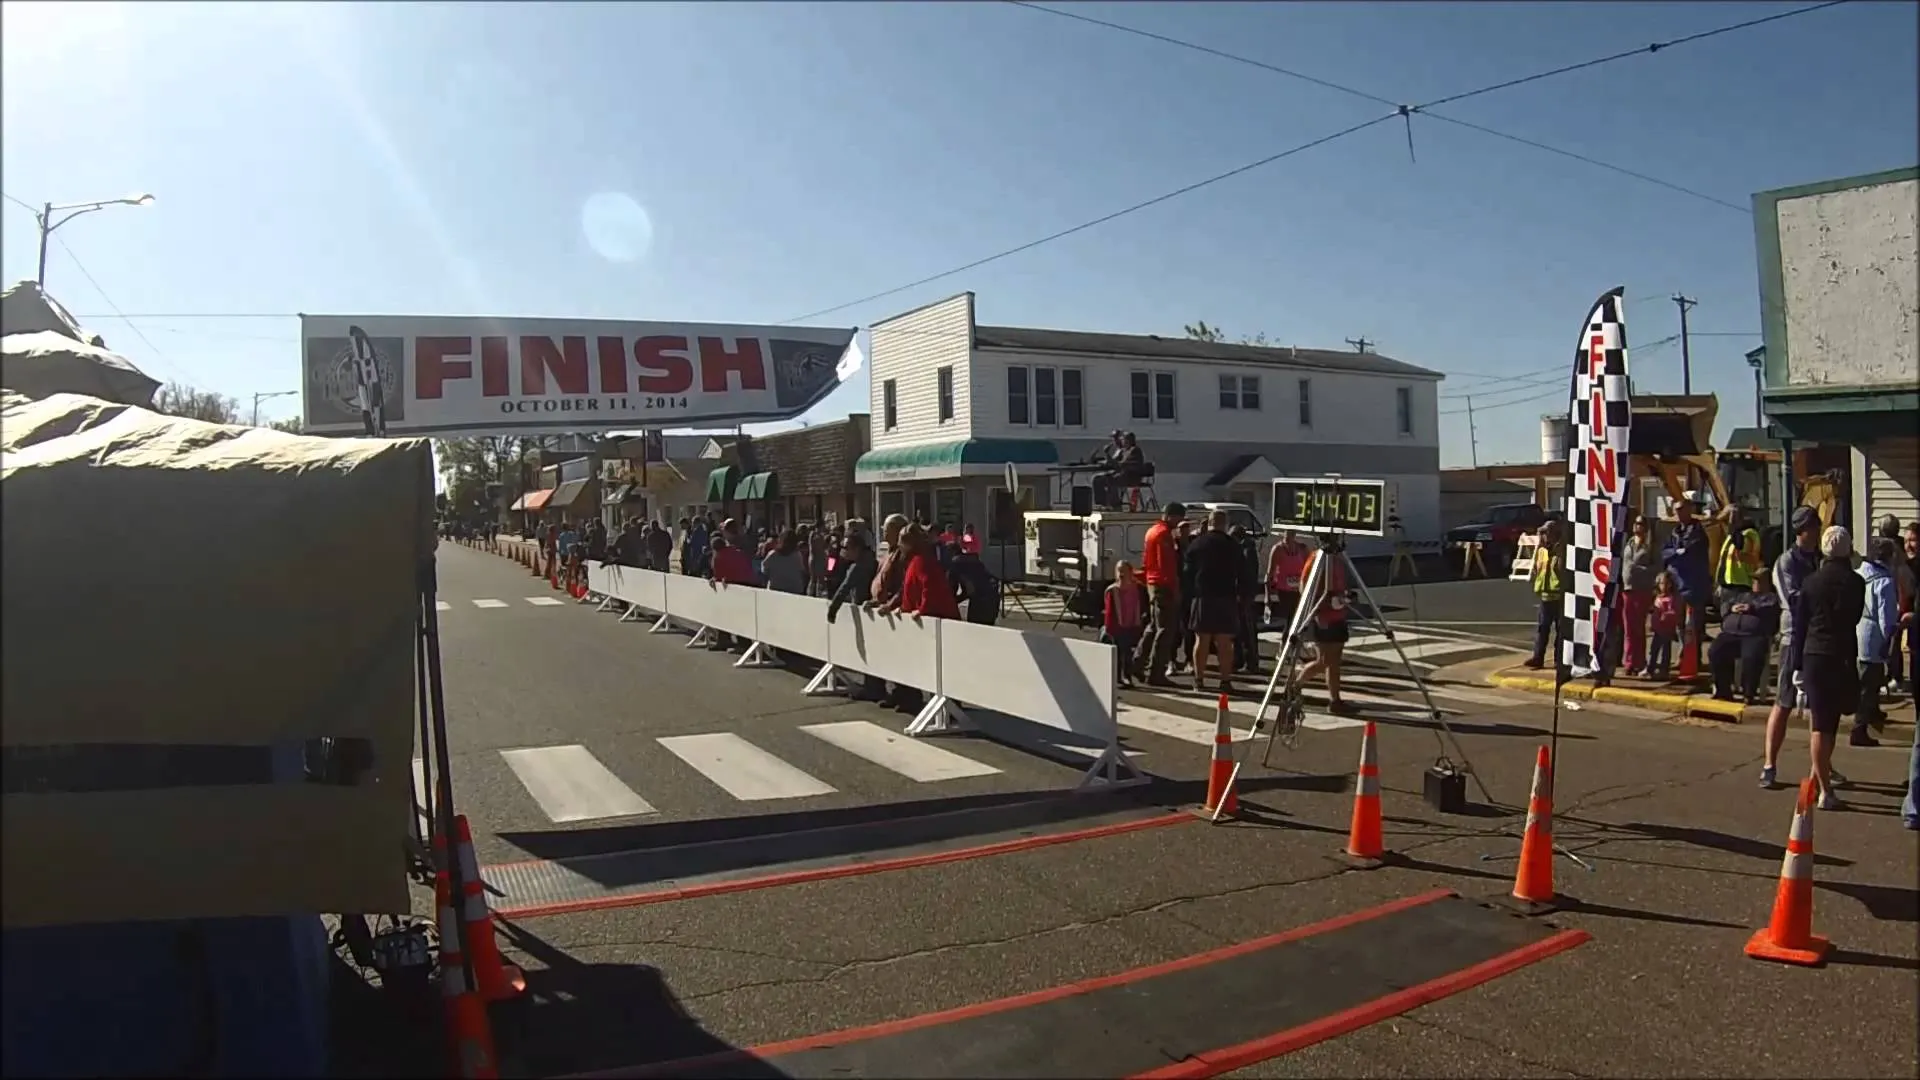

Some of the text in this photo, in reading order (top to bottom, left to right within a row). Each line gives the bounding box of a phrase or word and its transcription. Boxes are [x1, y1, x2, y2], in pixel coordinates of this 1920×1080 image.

[415, 335, 768, 399] FINISH
[501, 396, 689, 413] OCTOBER 11, 2014
